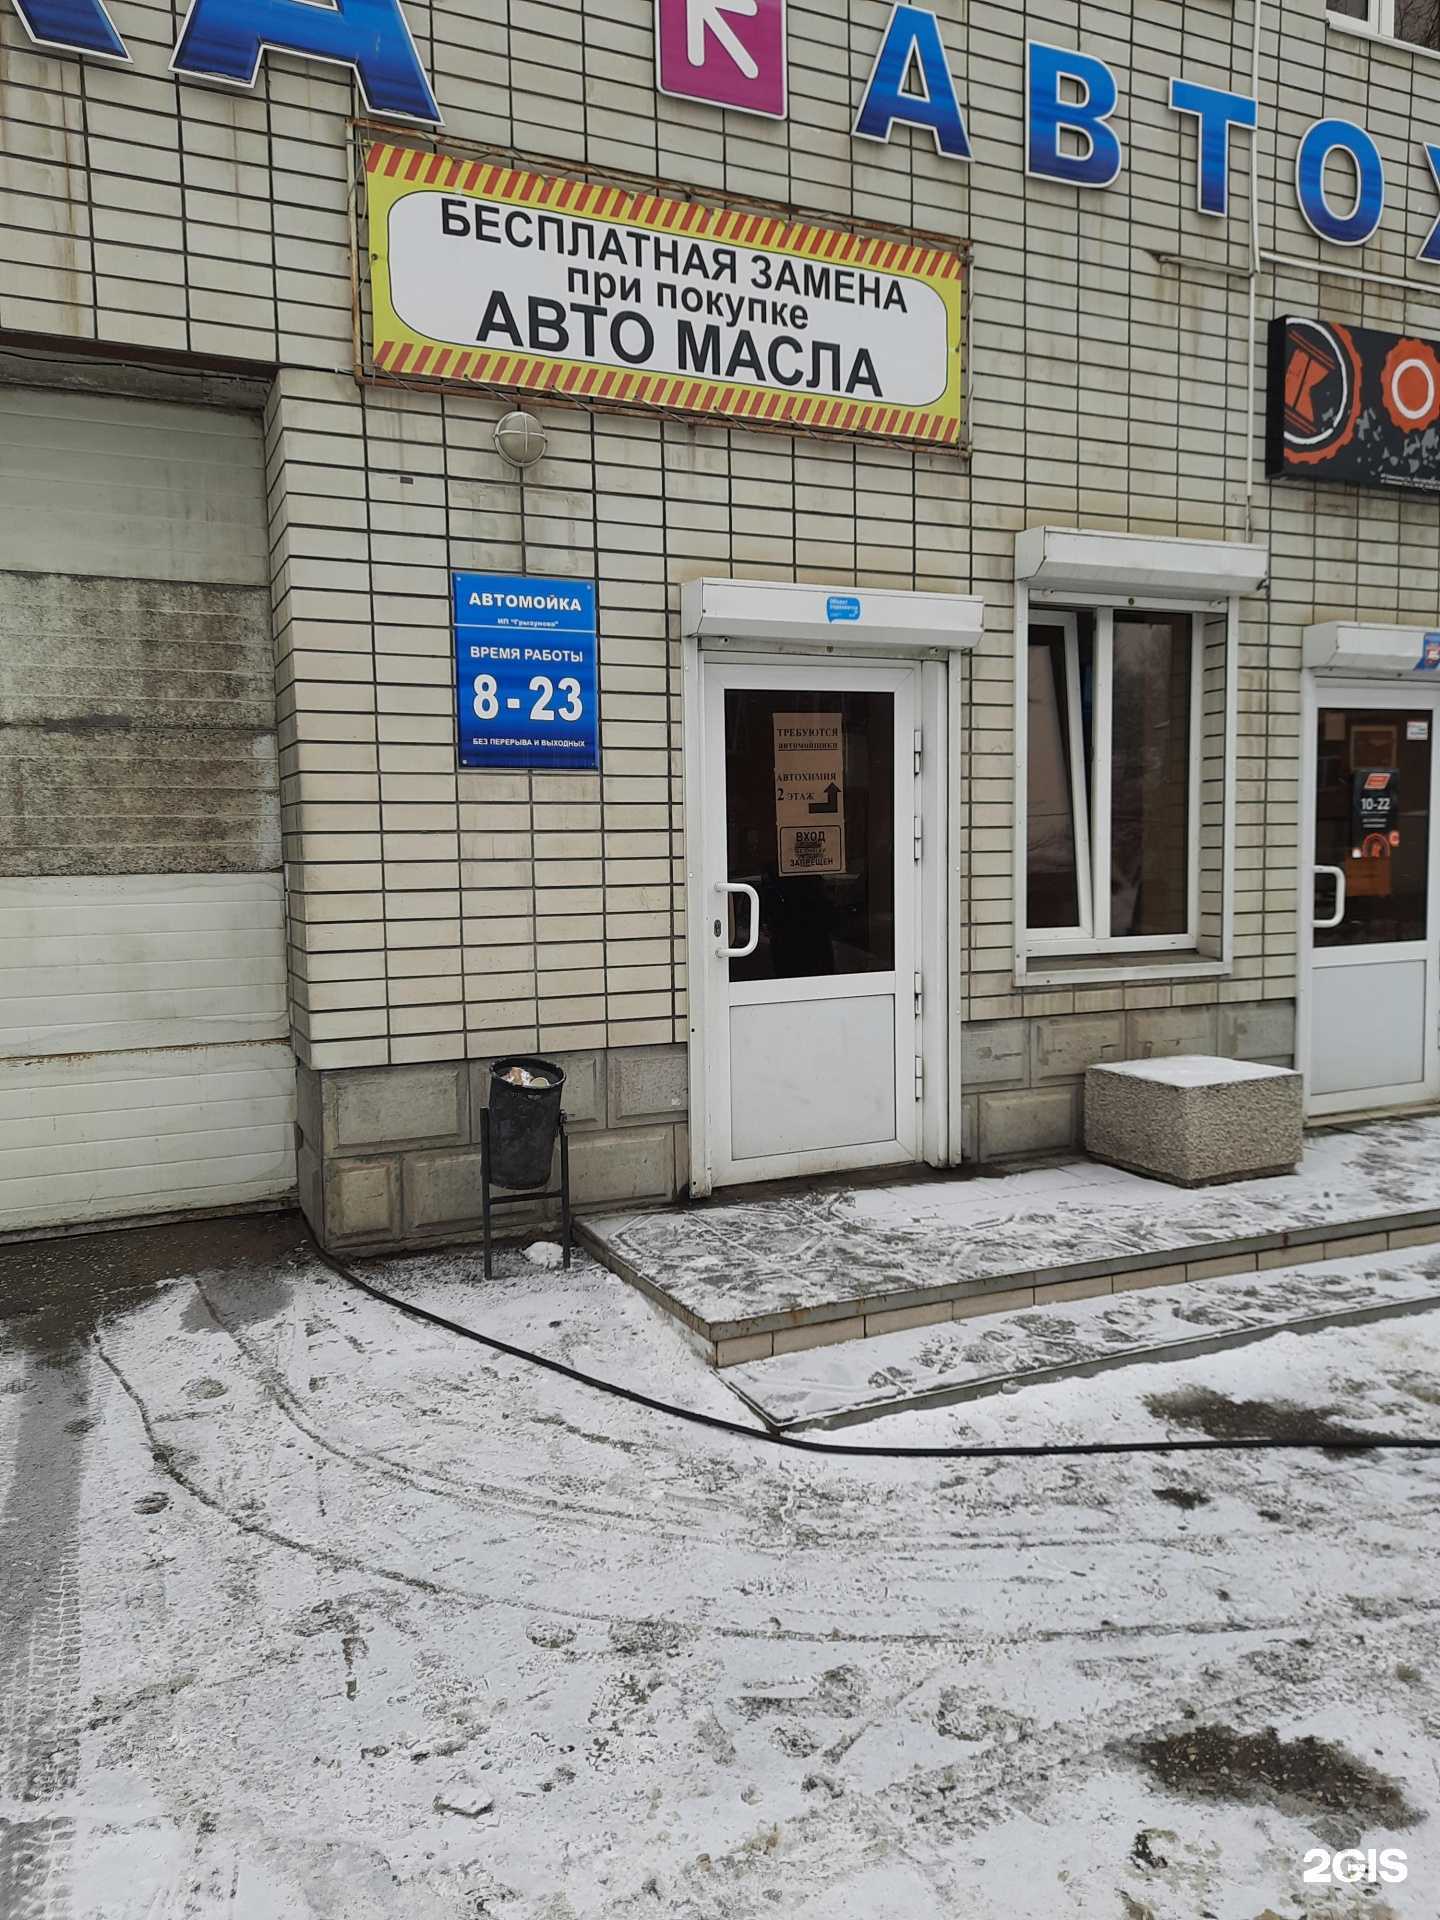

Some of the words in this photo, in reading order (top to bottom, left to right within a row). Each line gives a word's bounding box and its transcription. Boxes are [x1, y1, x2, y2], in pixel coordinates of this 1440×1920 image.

[441, 197, 737, 284] БЕСПЛАТНАЯ
[750, 254, 908, 313] ЗАМЕНА
[567, 266, 642, 305] при
[657, 281, 809, 330] покупке
[475, 289, 655, 364] АВТО
[677, 318, 883, 397] МАСЛА
[469, 592, 582, 611] АВТОМОЙКА
[470, 646, 520, 660] ВРЕМЯ
[524, 649, 583, 662] РАБОТЫ
[776, 728, 838, 737] ТРЕБУЮТСЯ
[473, 737, 488, 745] БЕЗ
[490, 738, 532, 746] ПЕРЕРЫВА
[541, 739, 585, 747] ВЫХОДНЫХ
[776, 772, 837, 782] АВТОХИМИЯ
[777, 788, 784, 801] 2
[788, 792, 816, 801] ЭТАЖ
[1360, 797, 1391, 811] 10-22
[796, 831, 826, 843] ВХОД
